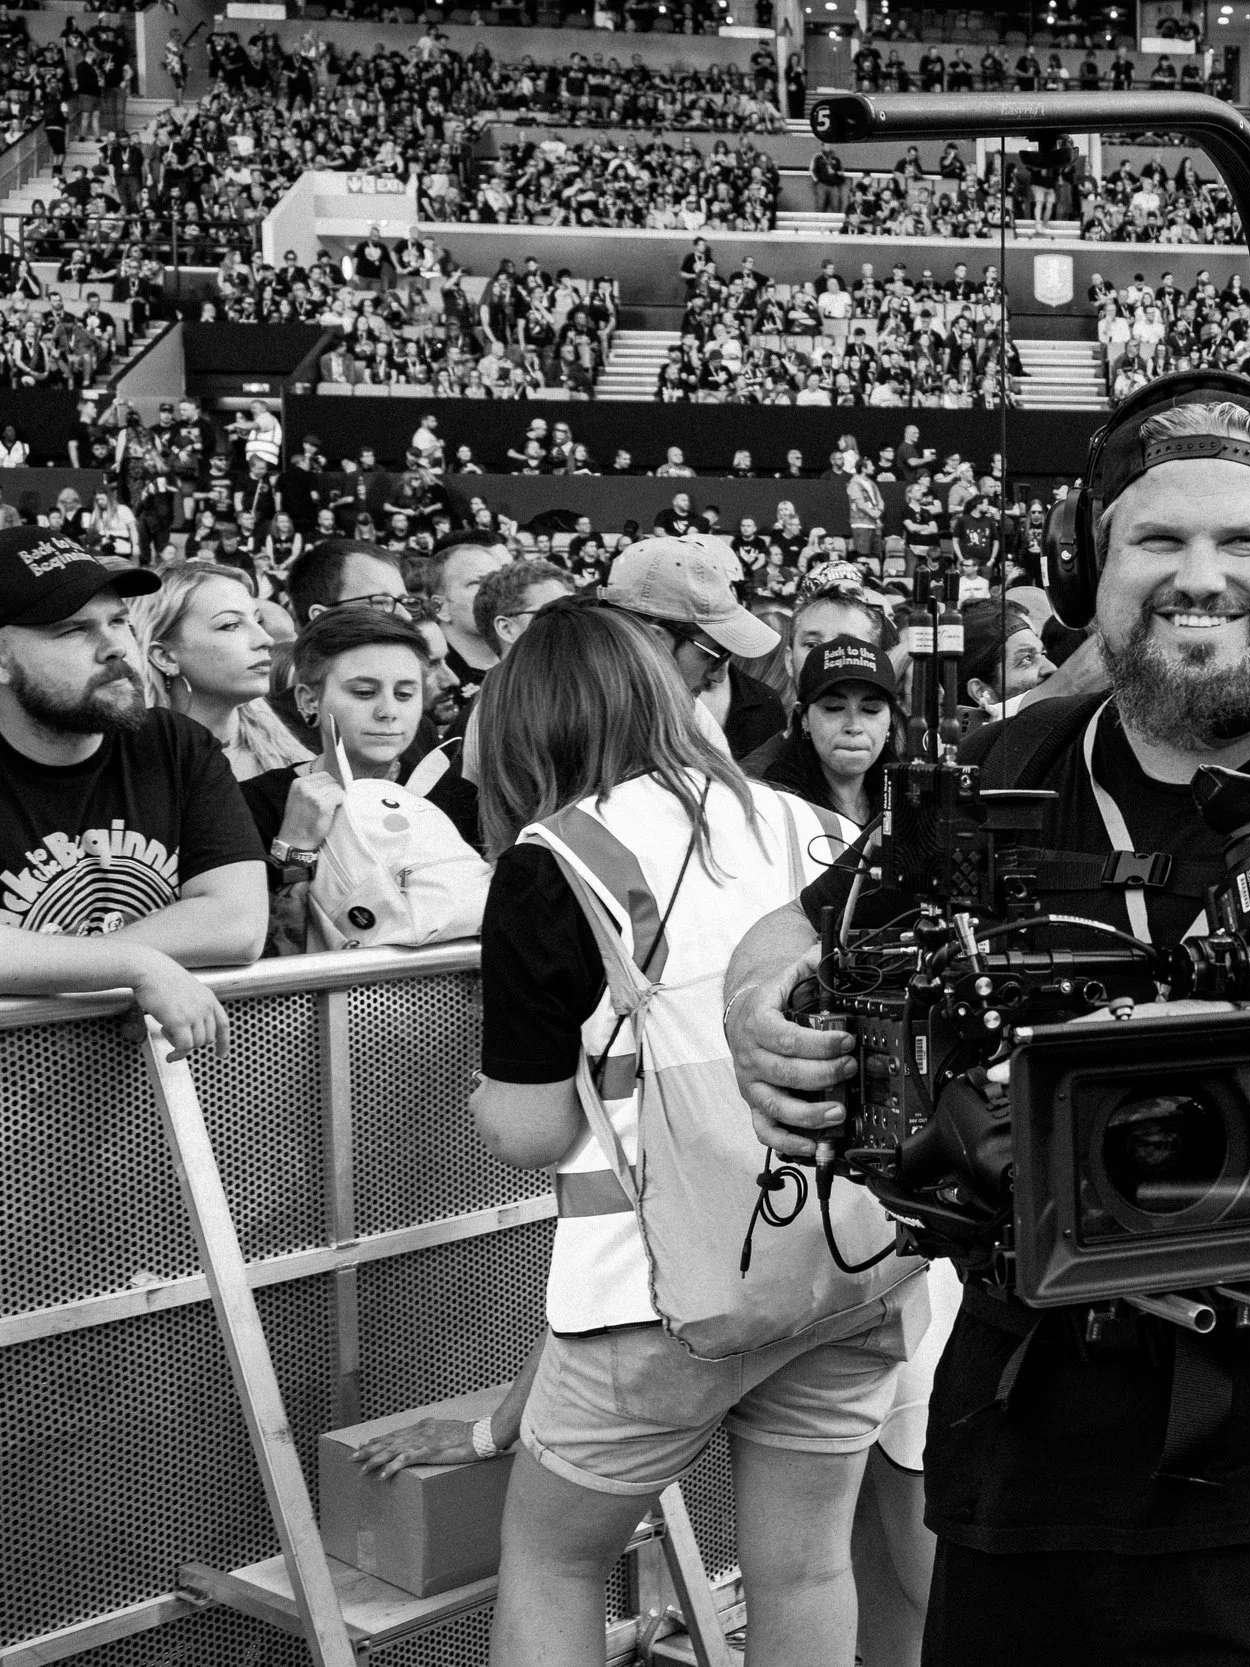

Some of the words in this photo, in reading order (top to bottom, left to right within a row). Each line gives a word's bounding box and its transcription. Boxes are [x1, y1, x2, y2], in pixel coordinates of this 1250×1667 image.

[816, 109, 831, 131] 5
[18, 541, 57, 564] Back
[824, 647, 845, 659] Back
[847, 646, 859, 655] to
[860, 648, 876, 660] the
[824, 656, 876, 672] Beginning
